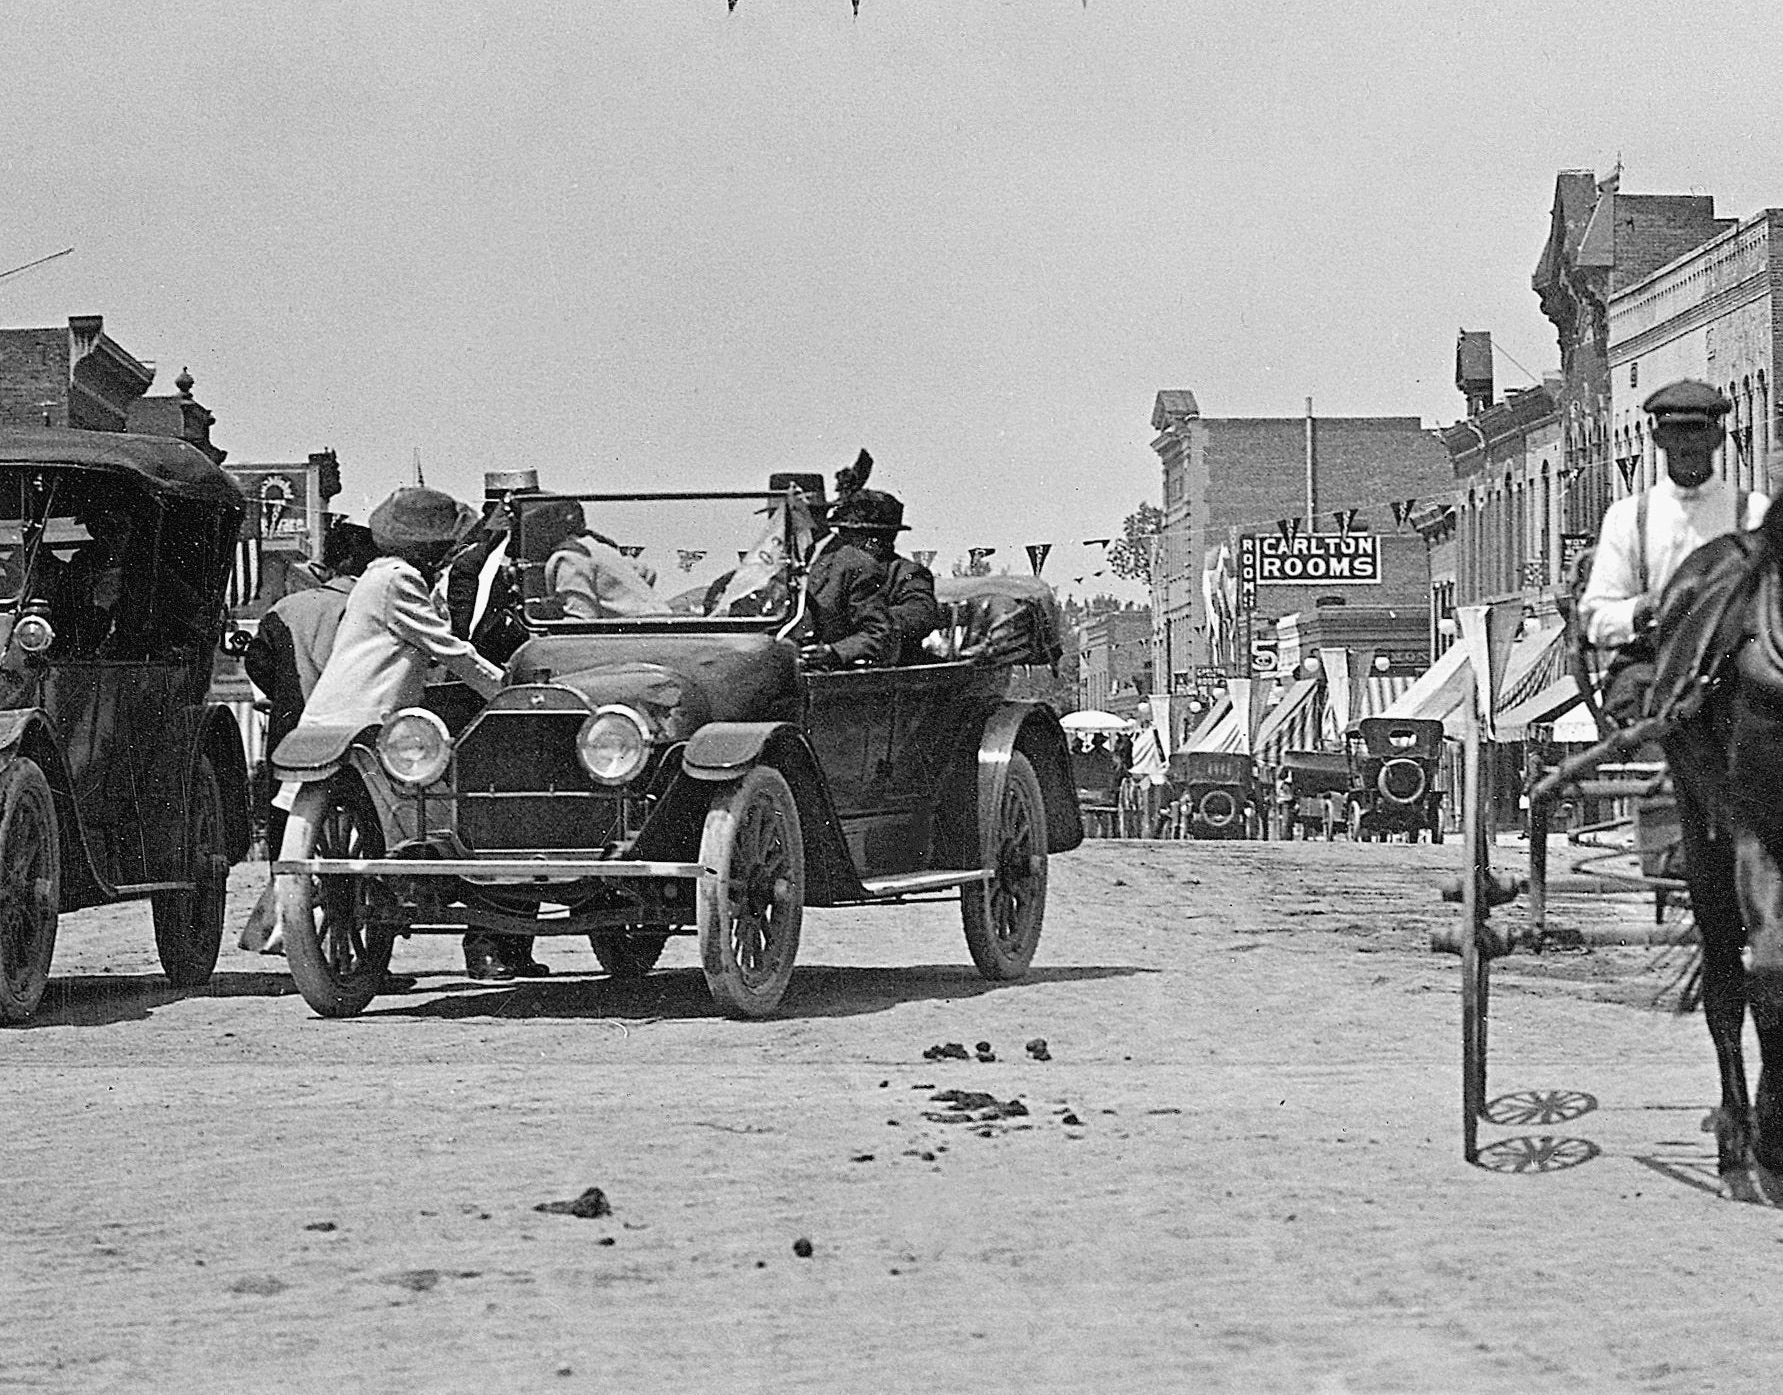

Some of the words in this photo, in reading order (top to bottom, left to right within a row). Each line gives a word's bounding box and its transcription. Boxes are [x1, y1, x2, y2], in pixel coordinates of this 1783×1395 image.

[1263, 537, 1374, 555] CARLTON
[1242, 539, 1255, 607] ROOMS
[1263, 557, 1374, 577] ROOMS
